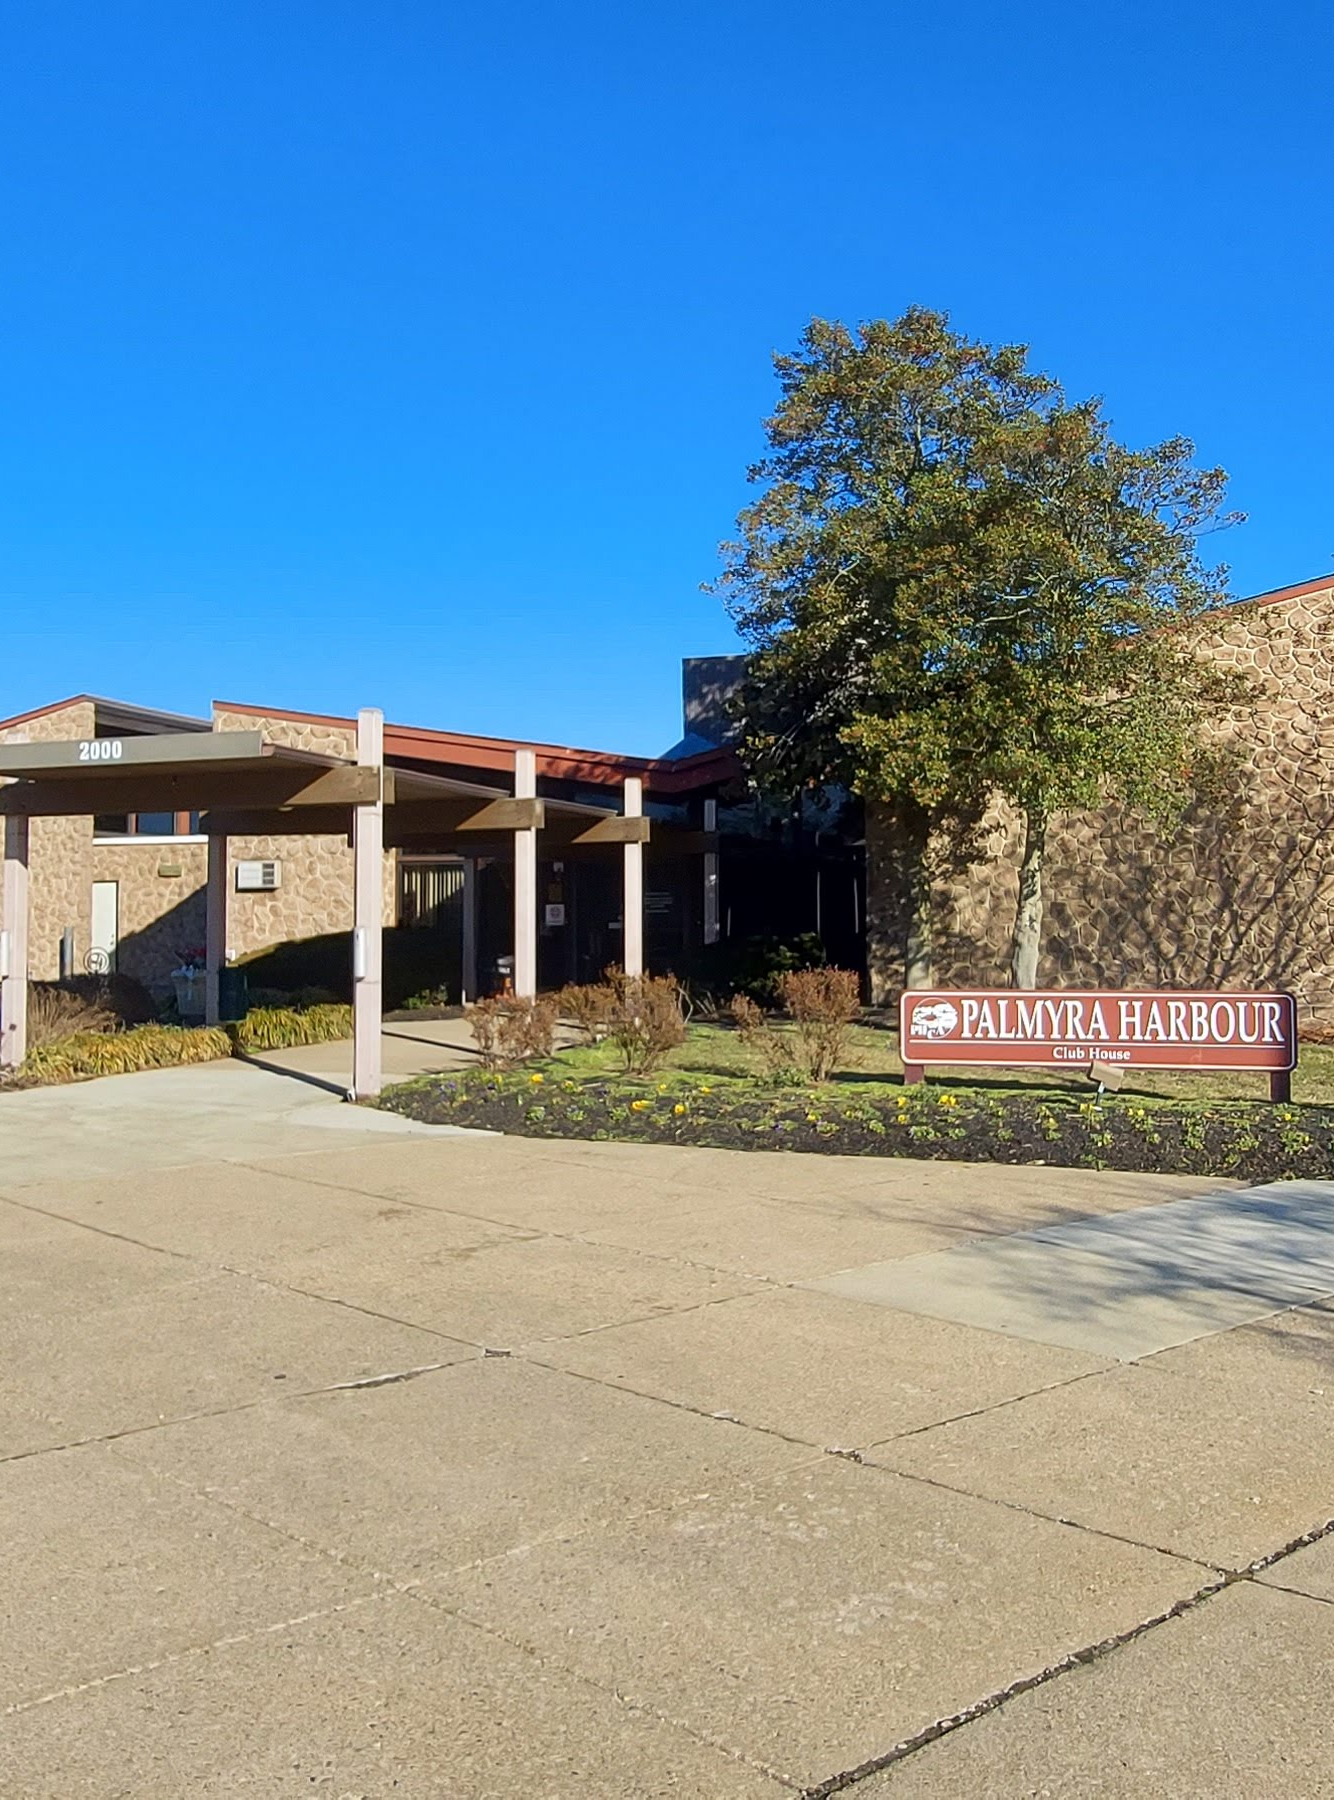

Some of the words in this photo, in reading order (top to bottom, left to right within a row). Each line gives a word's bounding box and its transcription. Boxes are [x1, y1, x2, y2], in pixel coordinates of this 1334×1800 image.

[79, 740, 122, 760] 2000
[961, 999, 1110, 1040] PALMYRA
[1117, 1000, 1285, 1043] HARBOUR
[1053, 1046, 1085, 1059] Club
[1089, 1047, 1131, 1060] House
